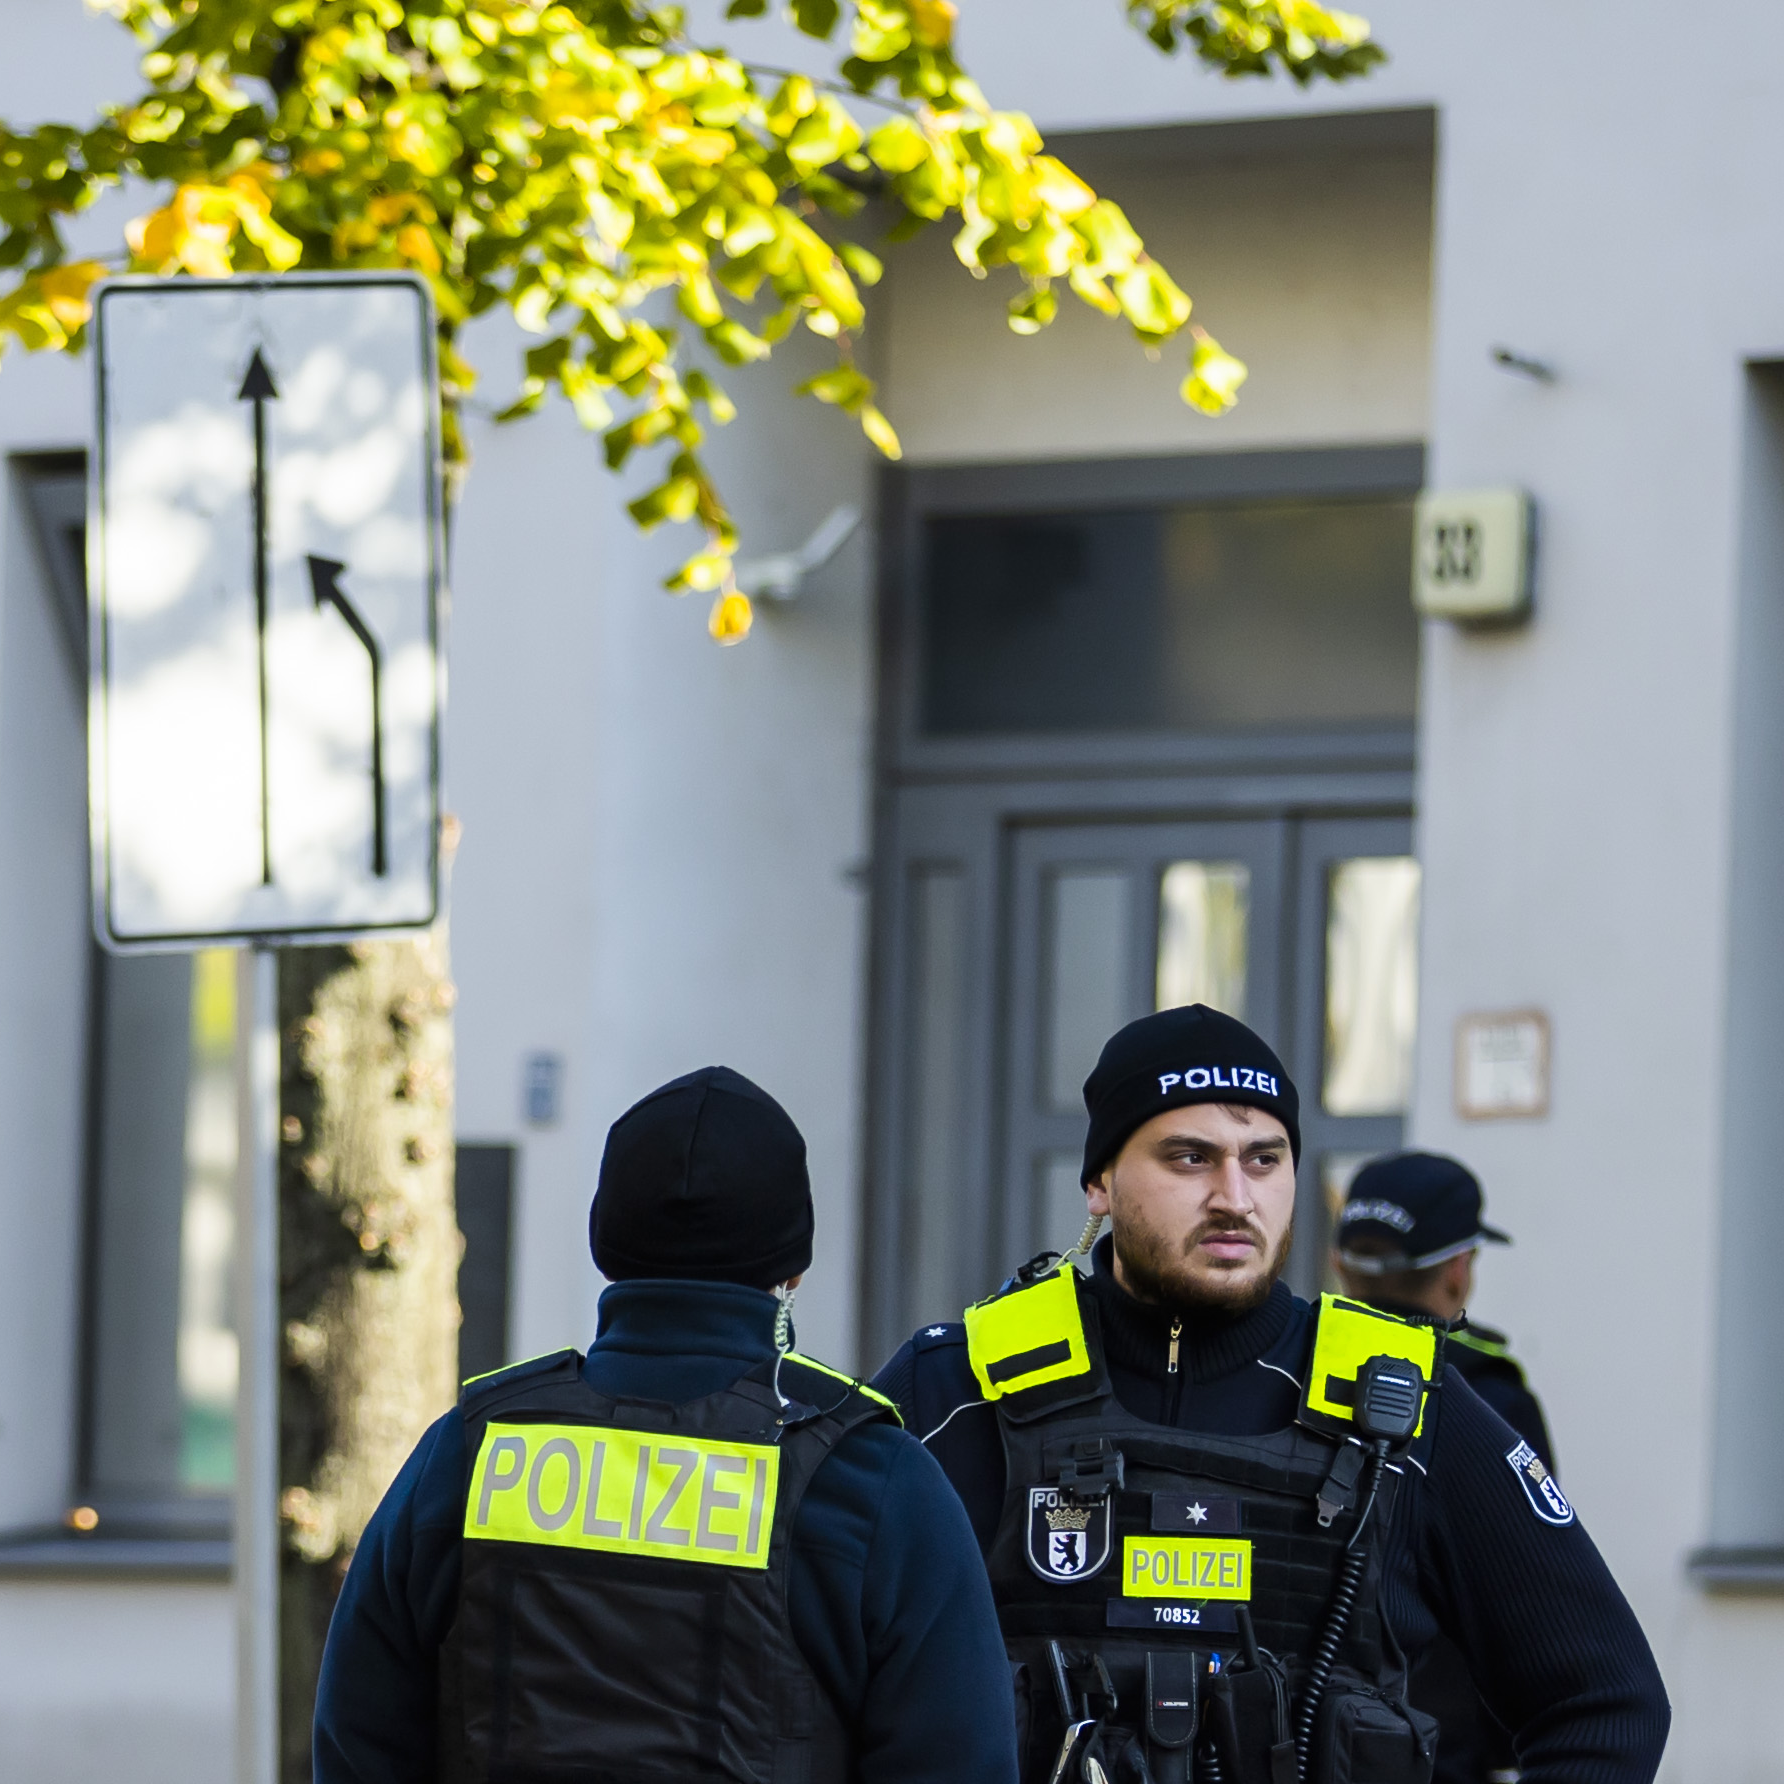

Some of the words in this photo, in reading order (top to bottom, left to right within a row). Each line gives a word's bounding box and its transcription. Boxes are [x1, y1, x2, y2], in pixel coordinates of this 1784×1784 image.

[1157, 1066, 1278, 1096] POLIZEI
[476, 1435, 768, 1555] POLIZEI
[1131, 1548, 1244, 1589] POLIZEI
[1152, 1606, 1201, 1625] 70852
